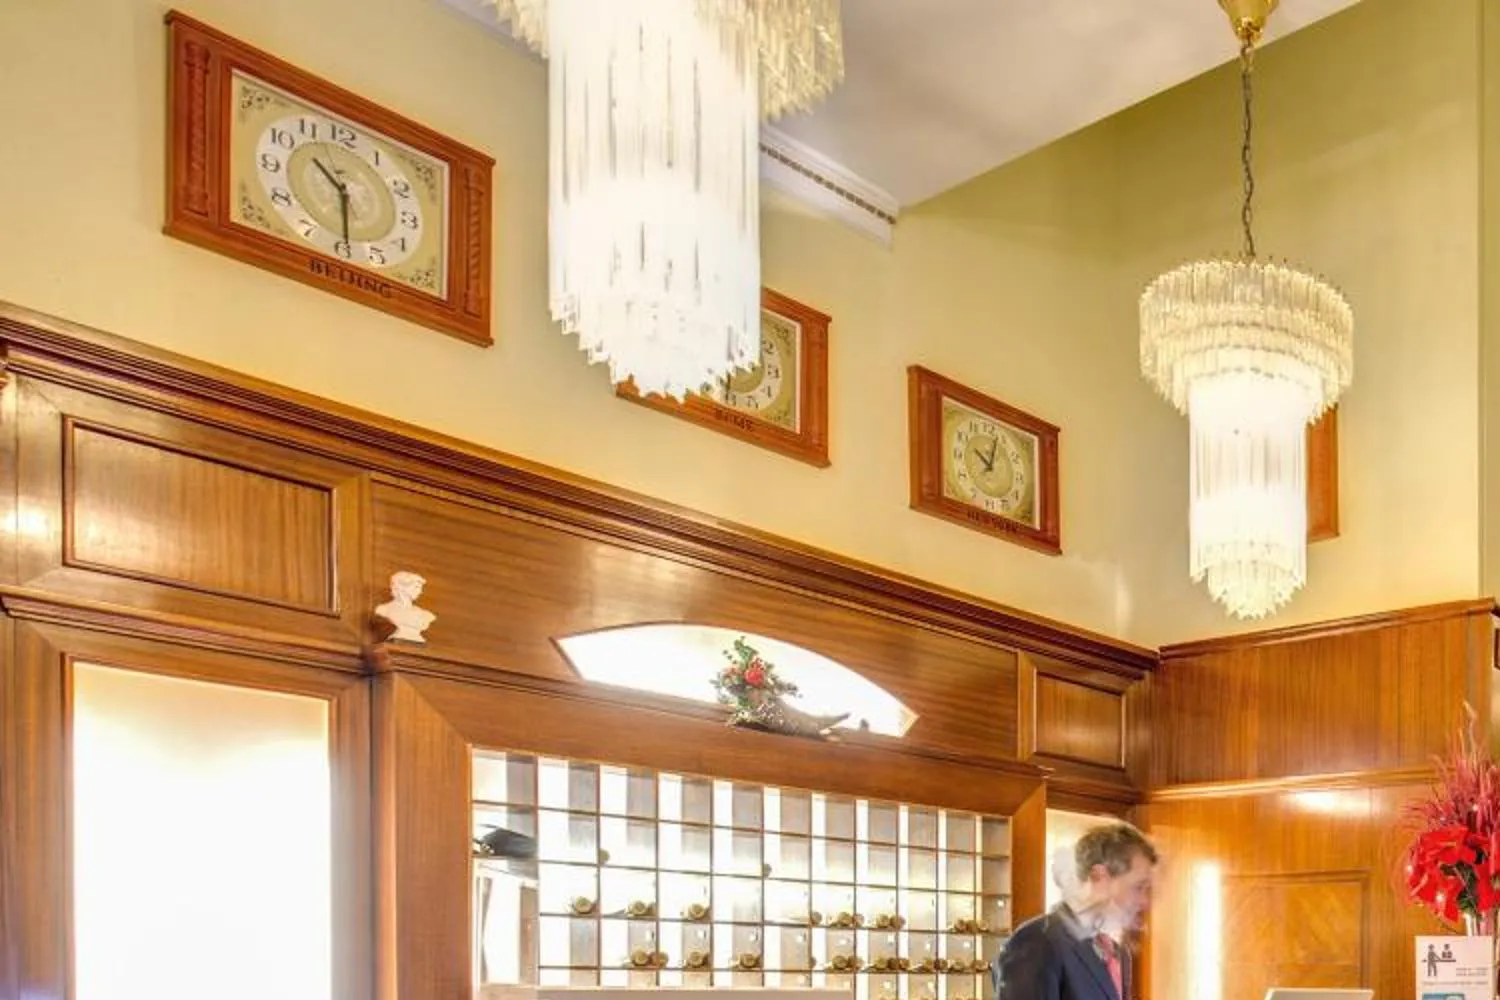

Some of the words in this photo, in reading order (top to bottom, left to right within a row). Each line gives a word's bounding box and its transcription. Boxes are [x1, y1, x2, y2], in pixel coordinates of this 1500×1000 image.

[271, 127, 295, 149] 10
[299, 118, 317, 139] 11
[330, 123, 356, 149] 12
[261, 153, 281, 173] 9
[373, 150, 380, 167] 1
[271, 188, 292, 207] 8
[393, 179, 410, 199] 2
[299, 219, 318, 237] 7
[401, 211, 419, 230] 3
[390, 237, 406, 253] 4
[368, 246, 386, 265] 5
[309, 256, 393, 299] BEIJING
